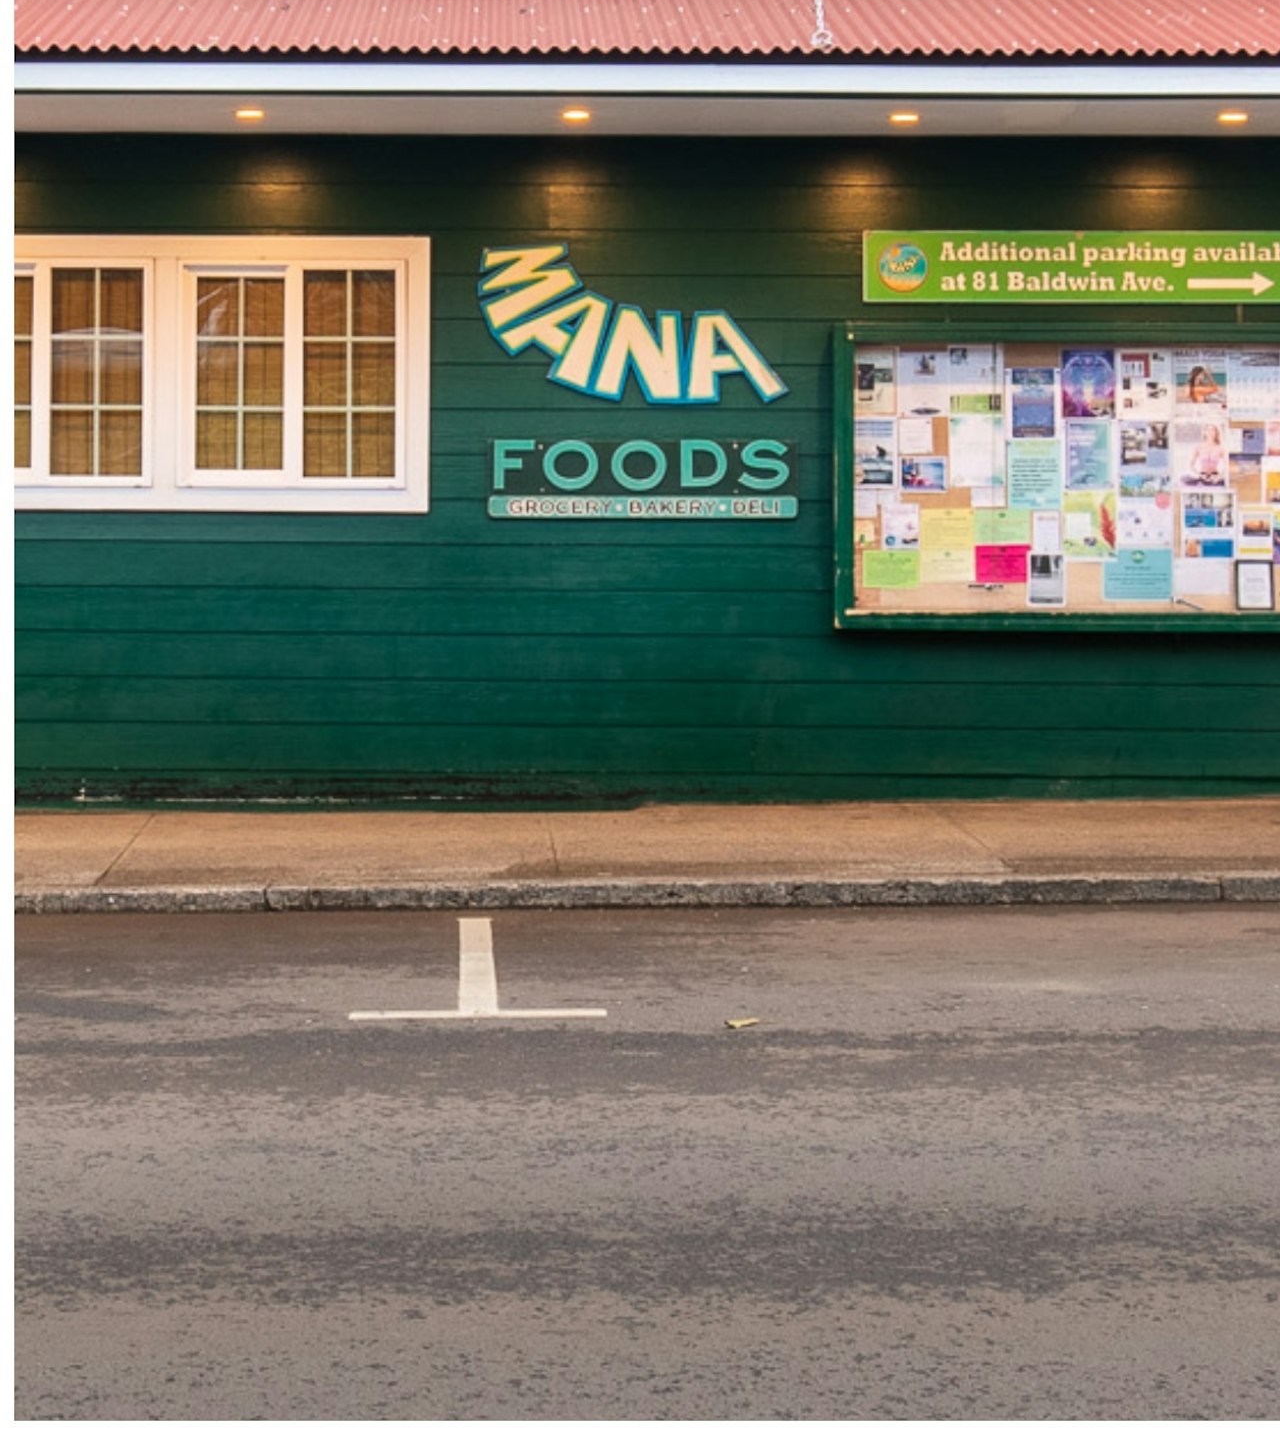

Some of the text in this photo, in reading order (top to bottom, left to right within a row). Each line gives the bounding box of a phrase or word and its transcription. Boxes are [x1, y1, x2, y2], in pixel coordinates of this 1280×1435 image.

[940, 241, 1076, 262] Additional
[1083, 241, 1187, 268] parking
[940, 270, 1175, 292] at 81 Baldwin Ave.
[479, 244, 789, 403] MANA
[493, 439, 790, 491] FOODS
[507, 498, 780, 515] GROCERY BAKERY DELI
